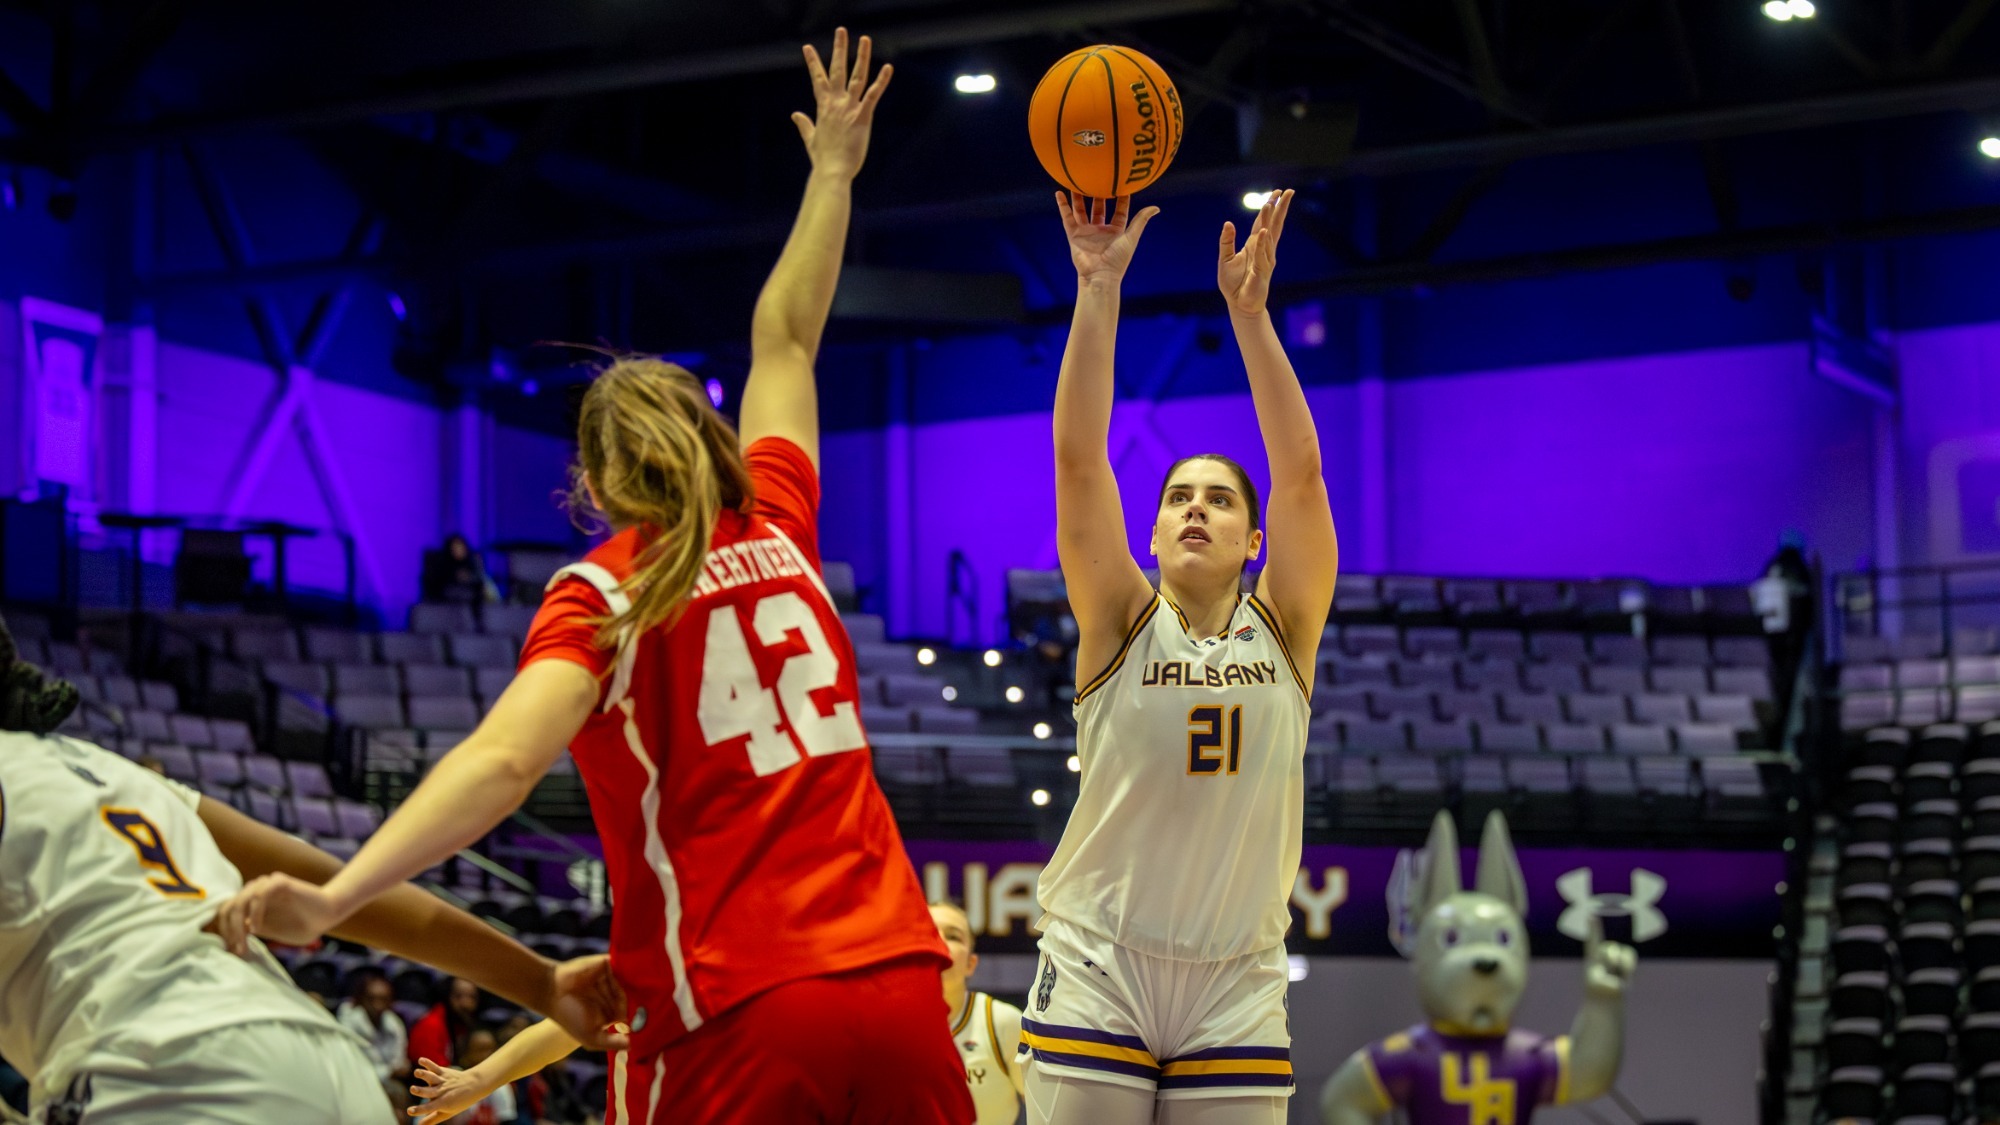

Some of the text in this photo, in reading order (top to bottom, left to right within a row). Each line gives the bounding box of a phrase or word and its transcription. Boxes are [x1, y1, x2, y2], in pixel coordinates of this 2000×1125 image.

[1125, 80, 1157, 184] Wilson
[697, 591, 867, 777] 42
[1141, 660, 1277, 688] UALBANY
[1187, 704, 1243, 776] 21
[100, 805, 207, 899] 9
